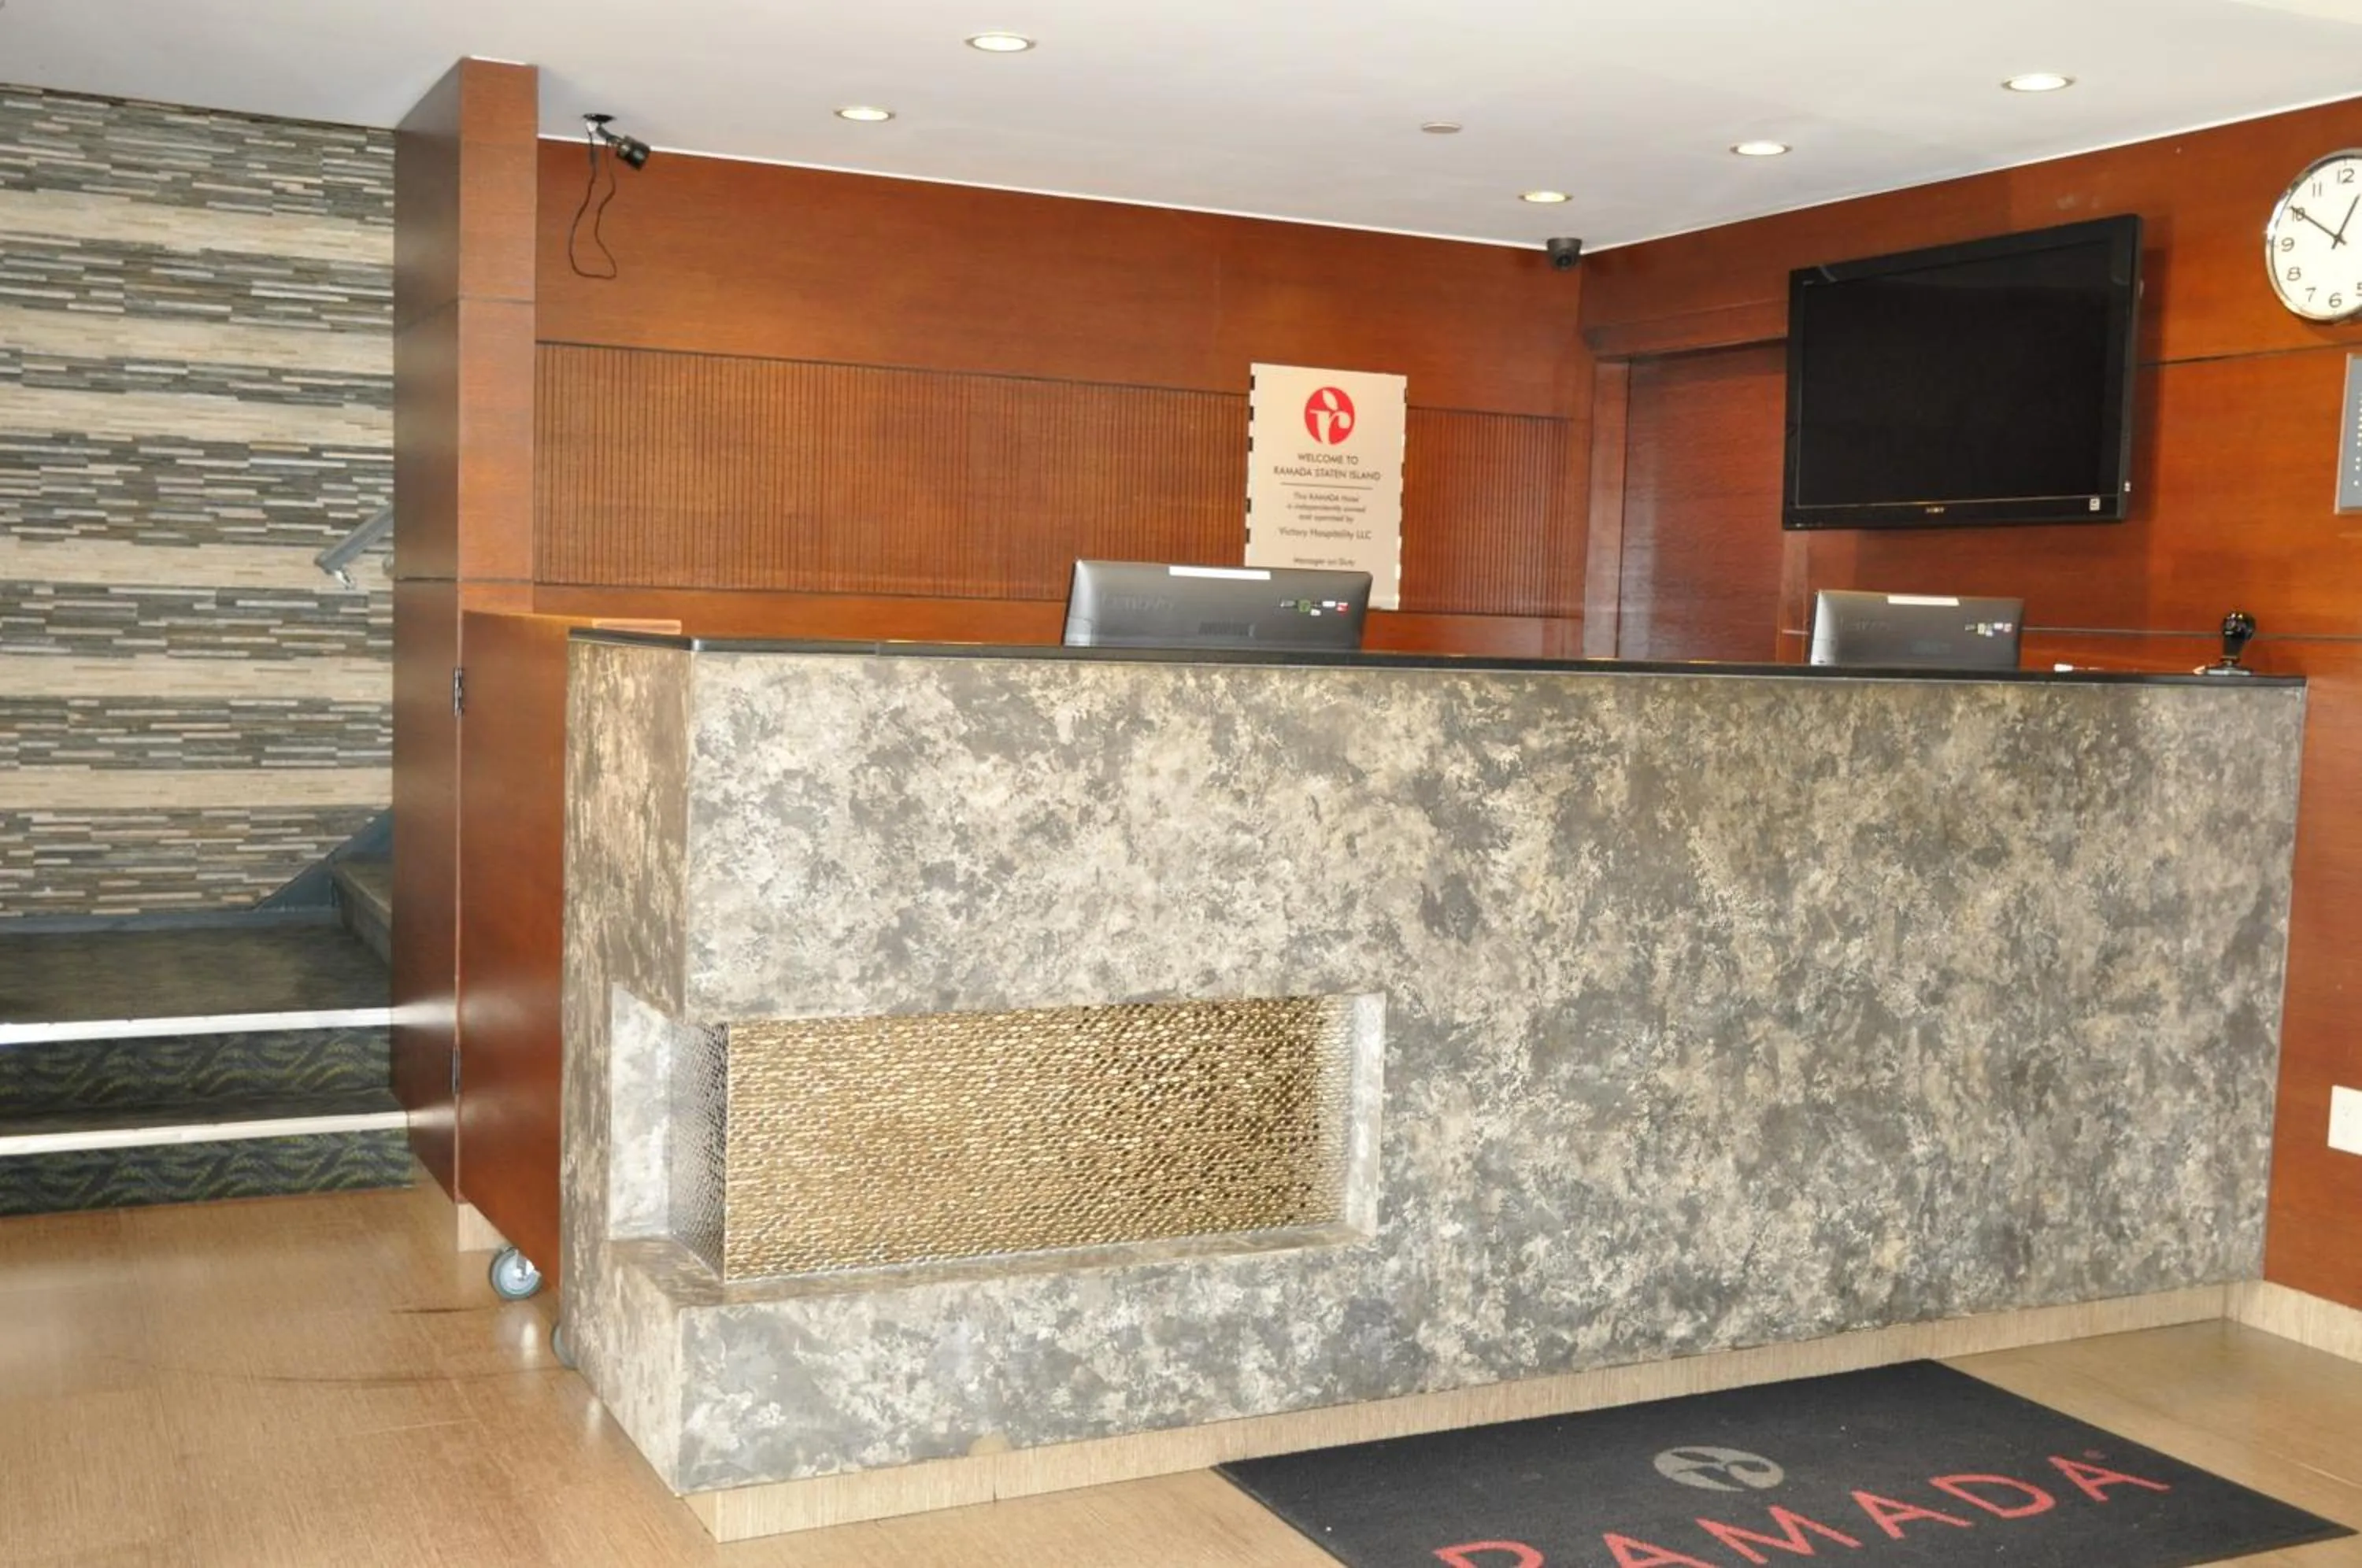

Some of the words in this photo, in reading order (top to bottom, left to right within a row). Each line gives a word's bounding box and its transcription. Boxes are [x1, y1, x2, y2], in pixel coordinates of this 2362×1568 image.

[2337, 168, 2355, 183] 12
[2312, 182, 2323, 197] 11
[2291, 207, 2305, 221] 10
[2281, 237, 2294, 252] 9
[2286, 266, 2301, 281] 8
[2305, 287, 2316, 302] 7
[2328, 292, 2342, 308] 6
[1298, 453, 1343, 464] WELCOME
[1346, 454, 1359, 465] TO
[1273, 465, 1312, 476] RAMADA
[1315, 468, 1346, 479] STATEN
[1349, 470, 1381, 481] ISLAND
